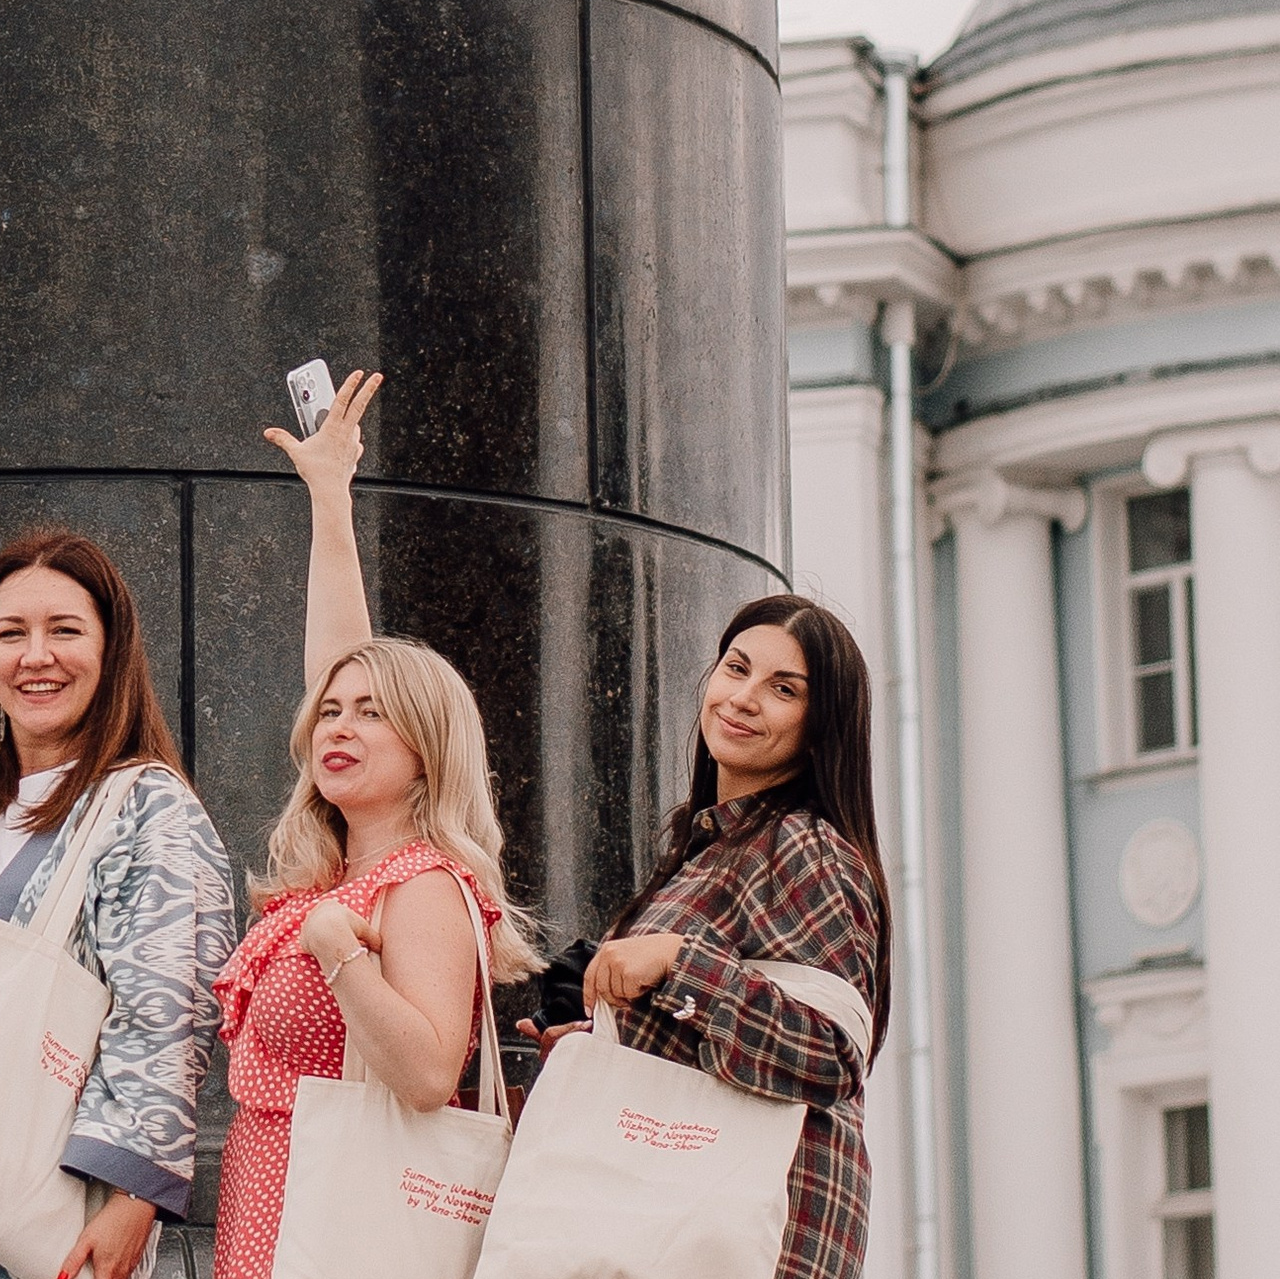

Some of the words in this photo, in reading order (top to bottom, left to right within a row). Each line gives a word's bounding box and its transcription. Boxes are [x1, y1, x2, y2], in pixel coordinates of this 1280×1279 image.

[44, 1030, 80, 1062] Summer
[617, 1119, 659, 1137] Nizhniy
[663, 1131, 717, 1144] Novgorod
[619, 1107, 666, 1129] Summer
[670, 1122, 720, 1136] Weekend
[624, 1131, 639, 1142] by
[399, 1180, 440, 1201] Nizhniy
[402, 1167, 447, 1191] Summer
[450, 1183, 496, 1203] Weekend
[407, 1194, 420, 1208] by
